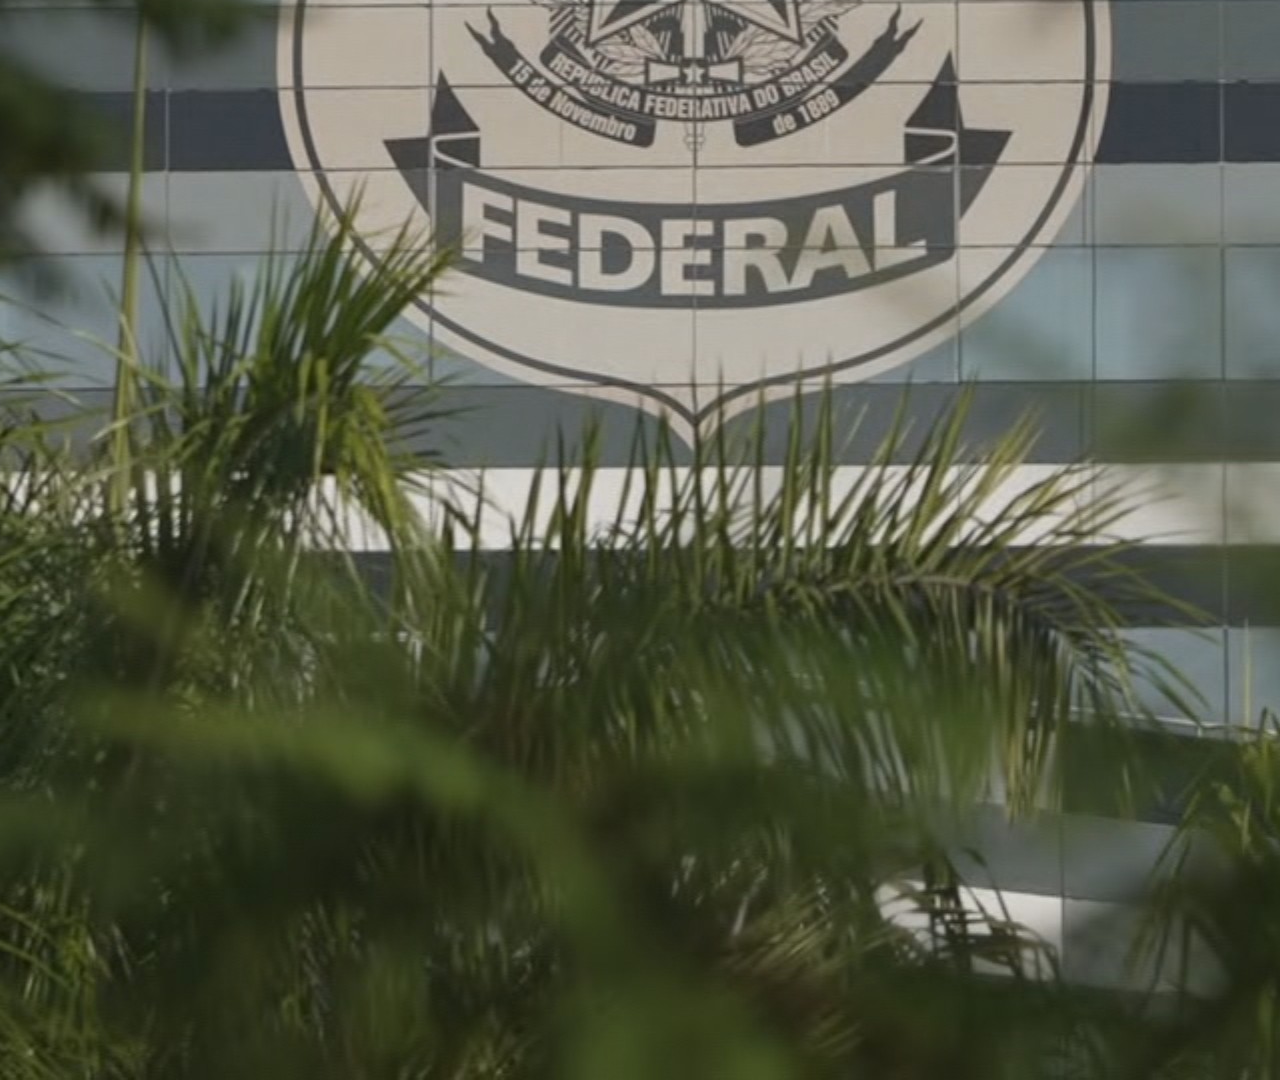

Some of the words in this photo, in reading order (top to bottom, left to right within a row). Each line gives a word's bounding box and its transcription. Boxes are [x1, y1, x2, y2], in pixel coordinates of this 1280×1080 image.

[509, 59, 534, 84] 15
[527, 78, 552, 102] de
[549, 91, 637, 141] Novembro
[643, 91, 752, 119] FEDERATIVA
[753, 85, 780, 109] DO
[780, 50, 840, 95] BRASIL
[772, 112, 797, 136] de
[797, 88, 840, 124] 1889
[462, 181, 928, 296] FEDERAL
